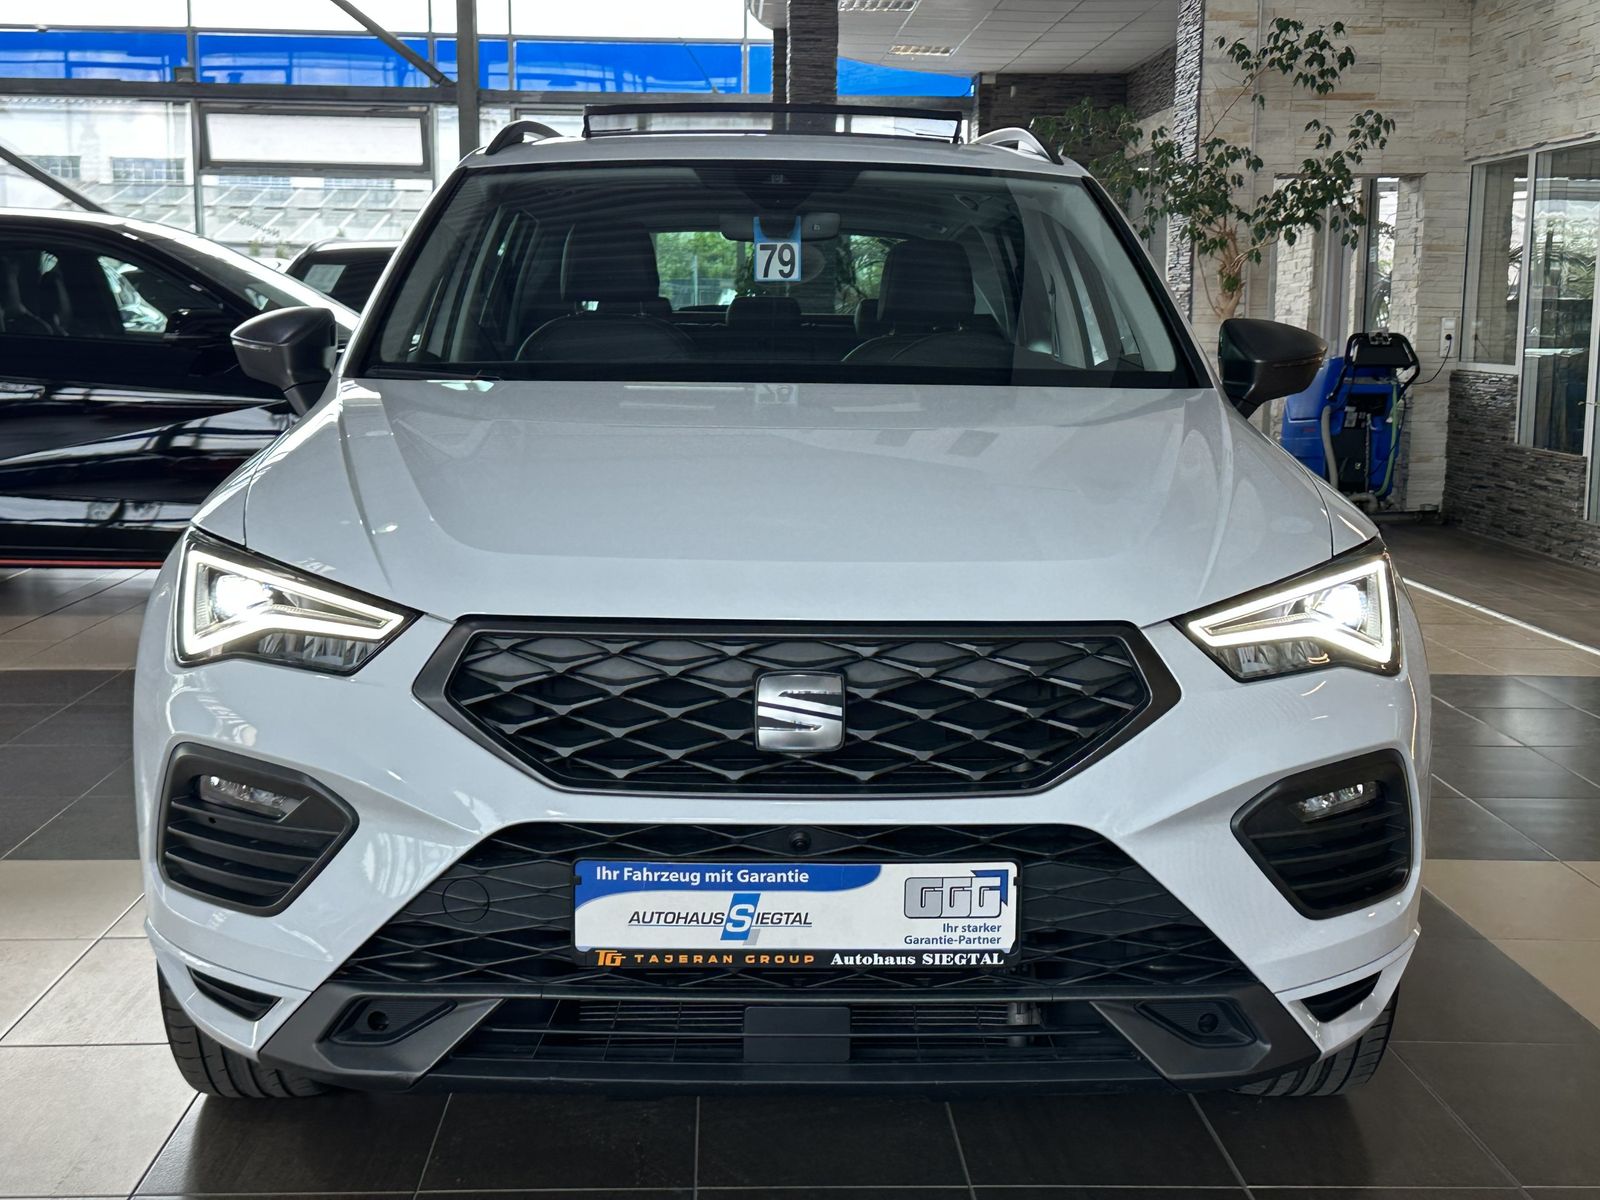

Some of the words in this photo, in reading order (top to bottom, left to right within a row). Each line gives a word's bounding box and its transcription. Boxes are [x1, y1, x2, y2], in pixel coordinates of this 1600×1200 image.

[759, 243, 796, 279] 79
[596, 866, 620, 880] Ihr
[623, 867, 701, 886] Fahrzeug
[705, 869, 733, 883] mit
[736, 869, 810, 883] Garantie
[628, 911, 725, 925] AUTOHAUS
[942, 922, 959, 933] Ihr
[961, 922, 1002, 933] starker
[904, 935, 1002, 945] Garantie-Partner
[634, 954, 733, 964] TAJERAN
[744, 954, 815, 964] GROUP
[830, 952, 916, 966] Autohaus
[921, 952, 1004, 966] SIEGTAL
